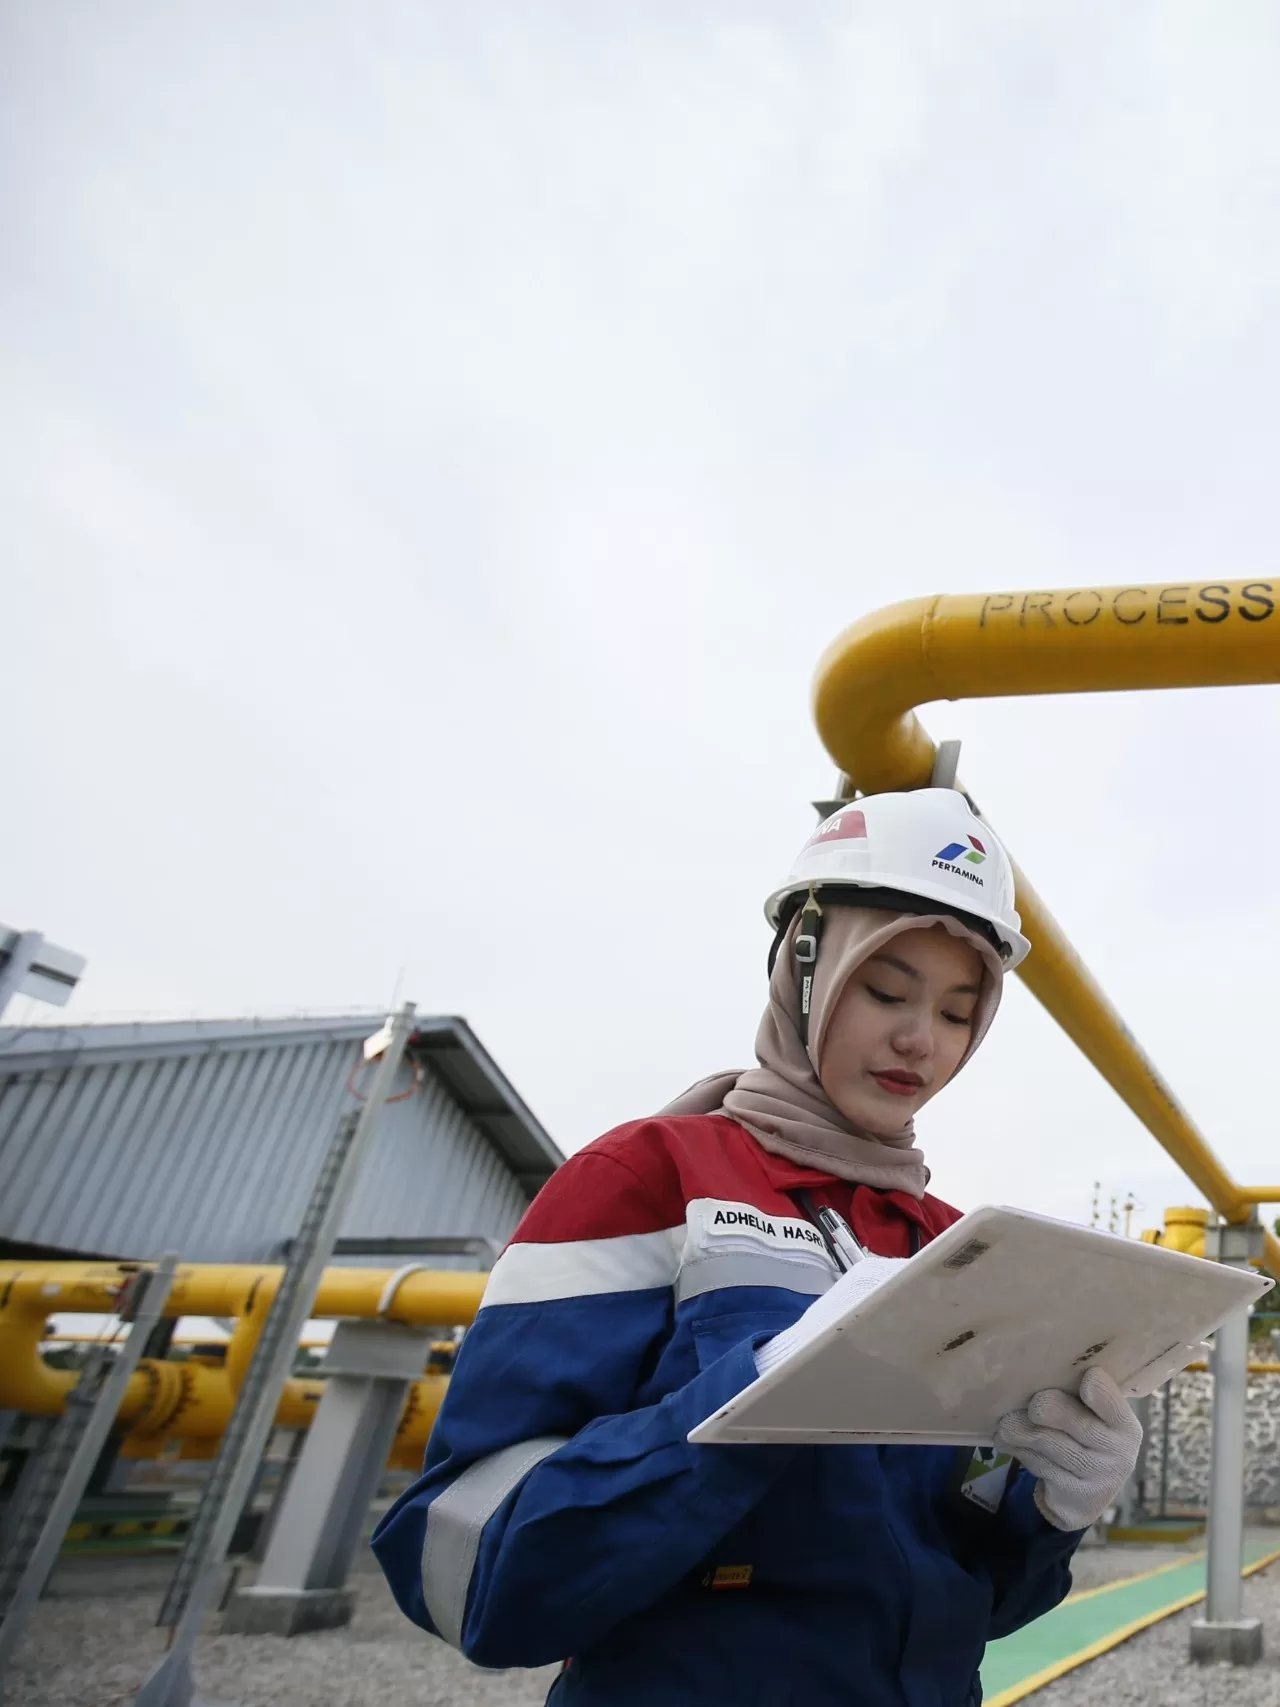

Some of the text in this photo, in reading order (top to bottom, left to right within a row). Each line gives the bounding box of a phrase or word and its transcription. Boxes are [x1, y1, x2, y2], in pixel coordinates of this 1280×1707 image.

[979, 584, 1275, 627] PROCESS
[931, 859, 984, 887] PERTAMINA
[714, 1210, 776, 1237] ADHELIA
